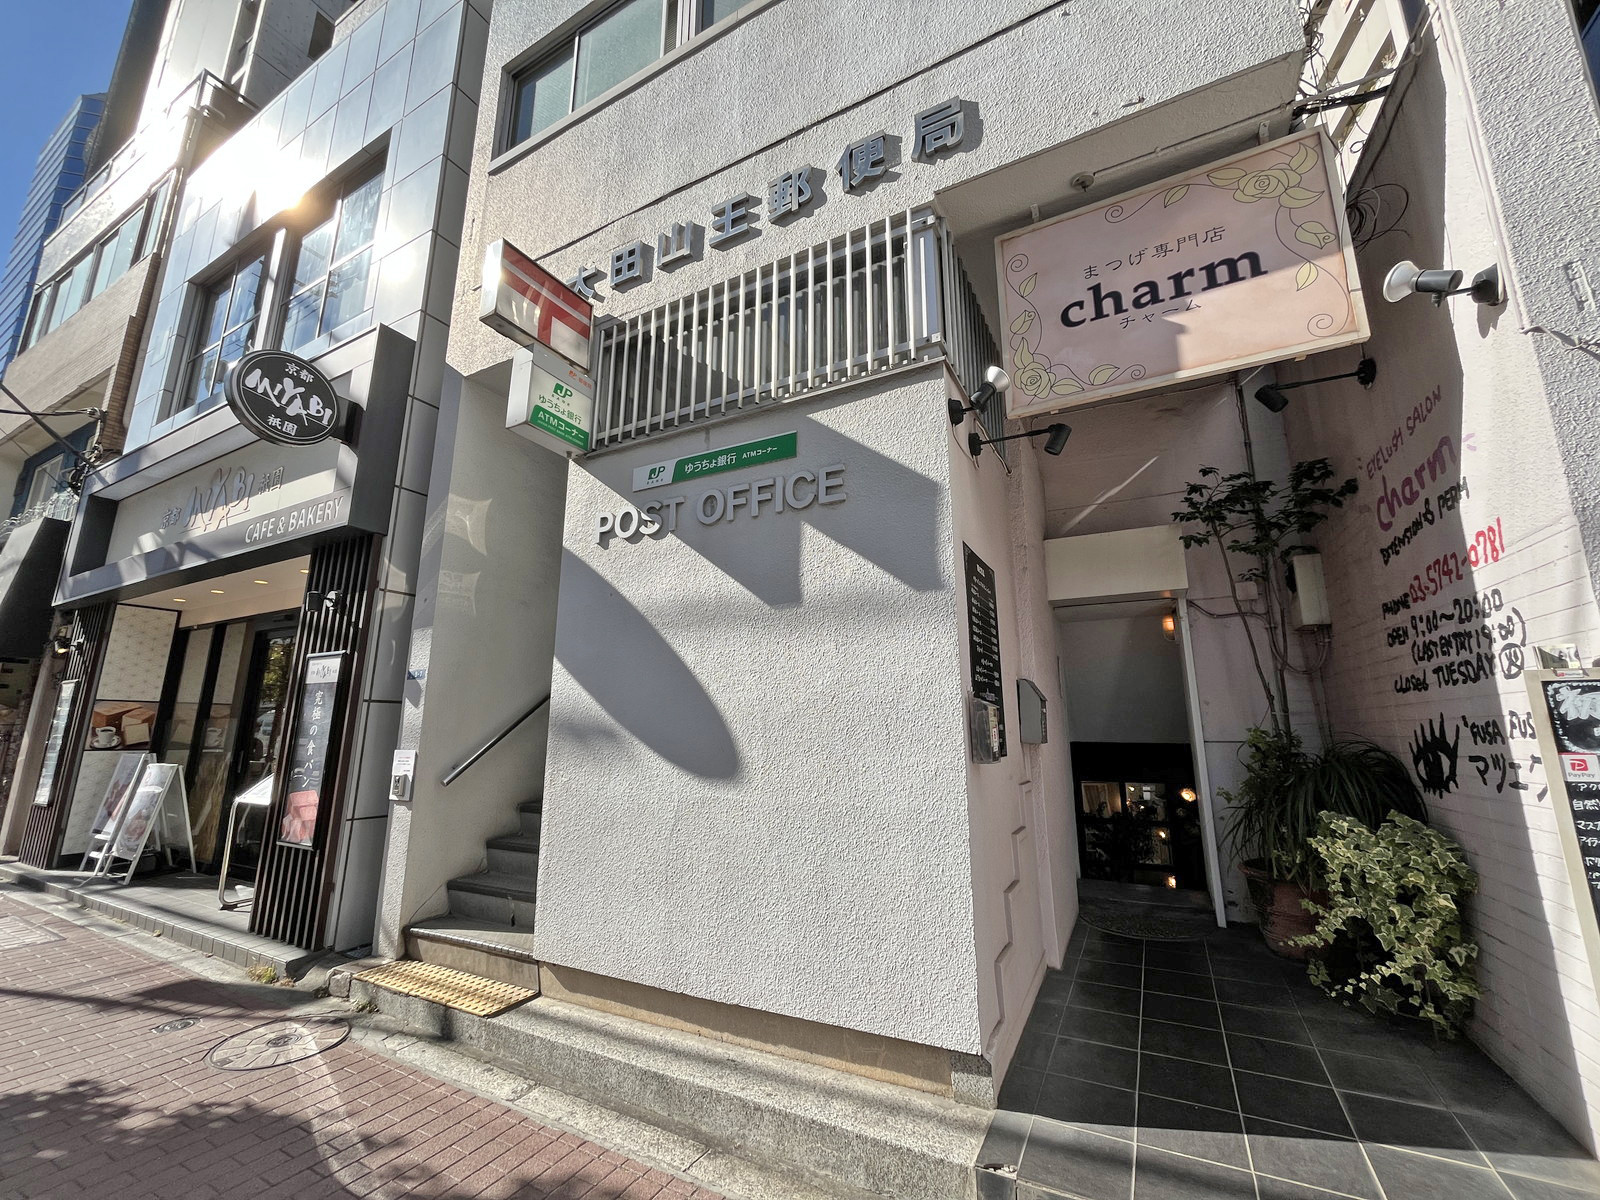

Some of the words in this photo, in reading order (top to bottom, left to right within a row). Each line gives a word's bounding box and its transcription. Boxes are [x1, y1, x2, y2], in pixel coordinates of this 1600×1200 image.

[564, 97, 965, 298] 大田山王郵便局
[1083, 225, 1226, 280] まつげ専門店
[1059, 250, 1268, 329] charm
[1119, 299, 1203, 330] チャーム
[285, 362, 314, 383] 京都
[245, 368, 333, 426] MIYABI
[552, 382, 573, 399] JP
[537, 410, 585, 439] ATMコーナー
[538, 394, 582, 425] ゆうちょ銀行
[1406, 384, 1442, 436] SALON
[647, 465, 666, 481] JP
[684, 452, 737, 474] ゆうちょ銀行
[742, 446, 778, 459] ATMコーナー
[1376, 435, 1458, 532] charm
[245, 517, 275, 545] CAFE
[276, 516, 286, 535] &
[288, 496, 345, 532] BAKERY
[595, 496, 685, 545] POST
[696, 464, 847, 526] OFFICE
[1387, 626, 1410, 648] OPEN
[1432, 651, 1496, 688] TUESDAY
[302, 690, 324, 788] 究極の食パン
[1568, 771, 1595, 779] PayPay
[1573, 798, 1600, 811] 自然
